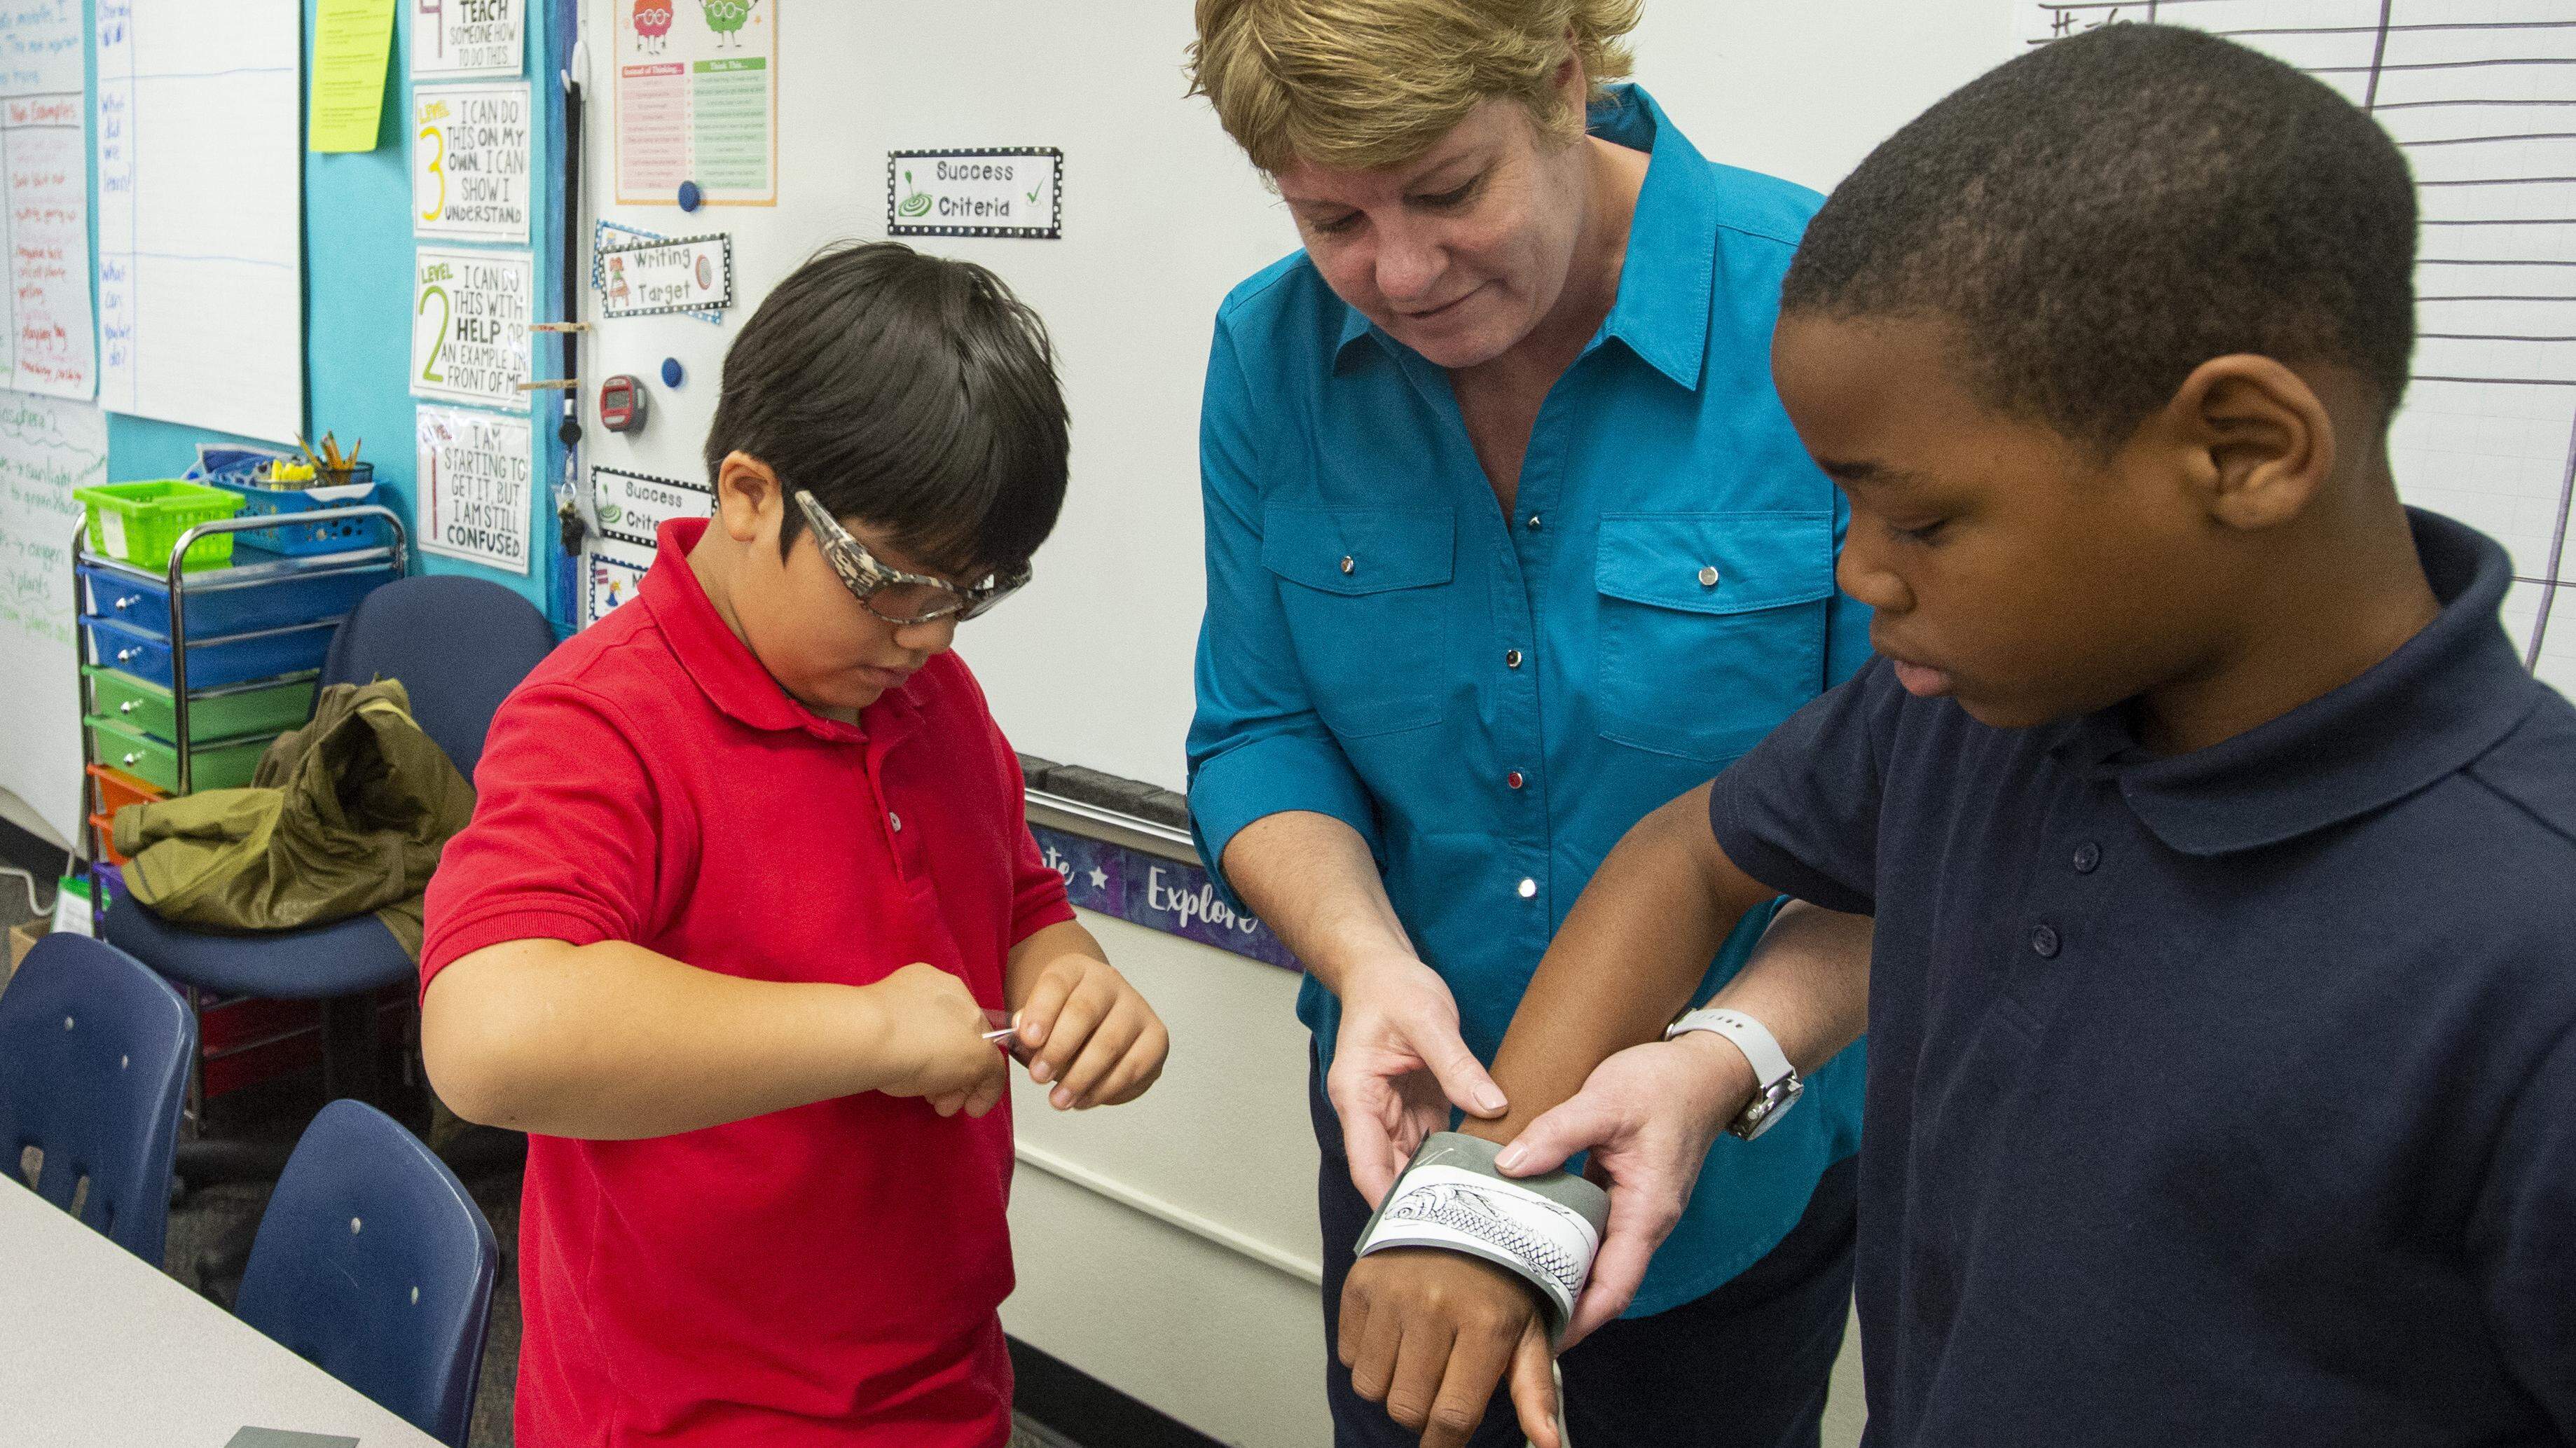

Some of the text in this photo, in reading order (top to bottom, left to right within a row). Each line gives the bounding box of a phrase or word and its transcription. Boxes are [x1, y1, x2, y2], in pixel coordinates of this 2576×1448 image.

[460, 0, 508, 23] TEACH
[450, 22, 516, 46] SOMEONE HOW
[460, 48, 469, 67] TO
[471, 48, 483, 66] DO
[462, 100, 518, 123] I CAN DO
[447, 126, 524, 150] THIS ON MY
[420, 126, 445, 221] 3
[486, 150, 493, 173] I
[495, 150, 523, 174] CAN
[937, 160, 1014, 181] Success
[462, 177, 509, 202] SHOW I
[445, 206, 522, 224] UNDERSTAND
[939, 195, 1010, 217] Criteria
[634, 247, 691, 270] Writing
[421, 263, 453, 284] LEVEL
[464, 266, 469, 289] I
[474, 266, 498, 290] CAN
[638, 280, 691, 304] Target
[453, 290, 523, 319] THIS WITH
[419, 285, 449, 382] 2
[456, 317, 501, 345] HELP
[441, 344, 456, 363] AN
[461, 345, 507, 369] EXAMPLE
[447, 365, 486, 391] FRONT
[490, 371, 503, 393] OF
[473, 425, 501, 452] I AM
[444, 447, 525, 482] STARTING TO
[452, 474, 473, 498] GET
[497, 481, 520, 506] BUT
[626, 481, 682, 508] Success
[454, 499, 518, 535] I AM STILL
[626, 511, 660, 532] Crite
[1042, 846, 1075, 886] te
